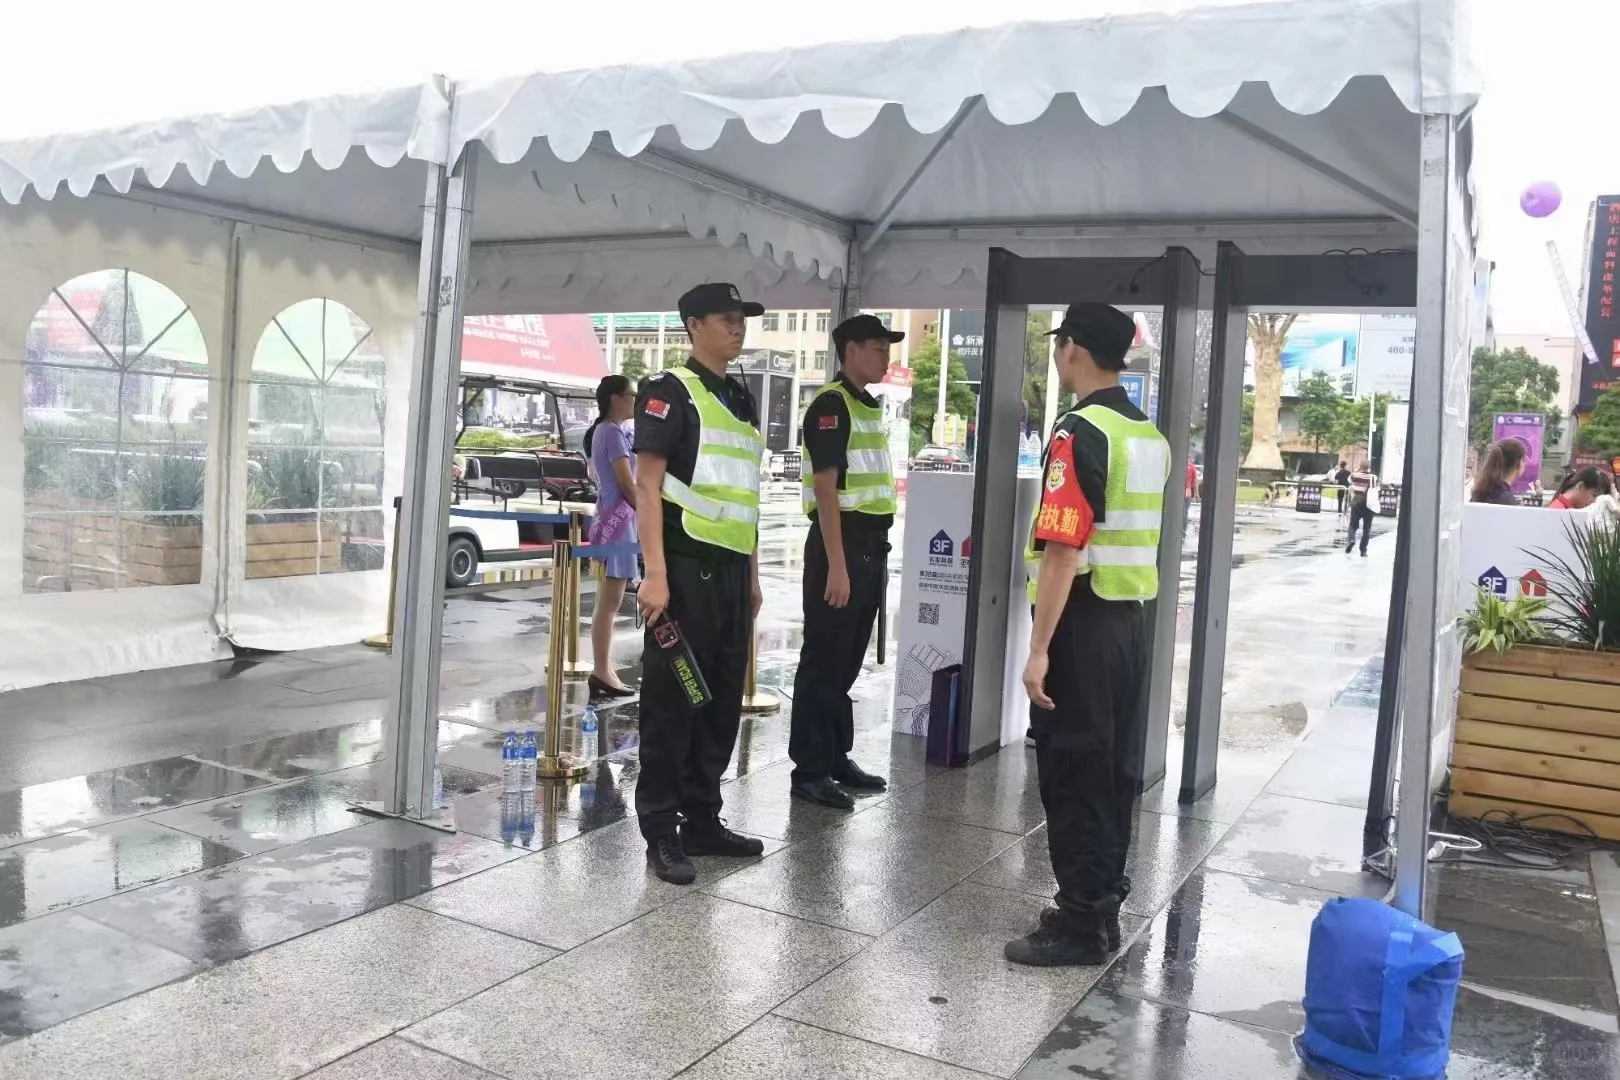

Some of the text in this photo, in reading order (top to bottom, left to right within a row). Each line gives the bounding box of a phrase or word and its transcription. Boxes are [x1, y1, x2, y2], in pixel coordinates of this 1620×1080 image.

[932, 539, 950, 553] 3F
[1482, 576, 1503, 591] 3F
[684, 678, 704, 704] SUPER
